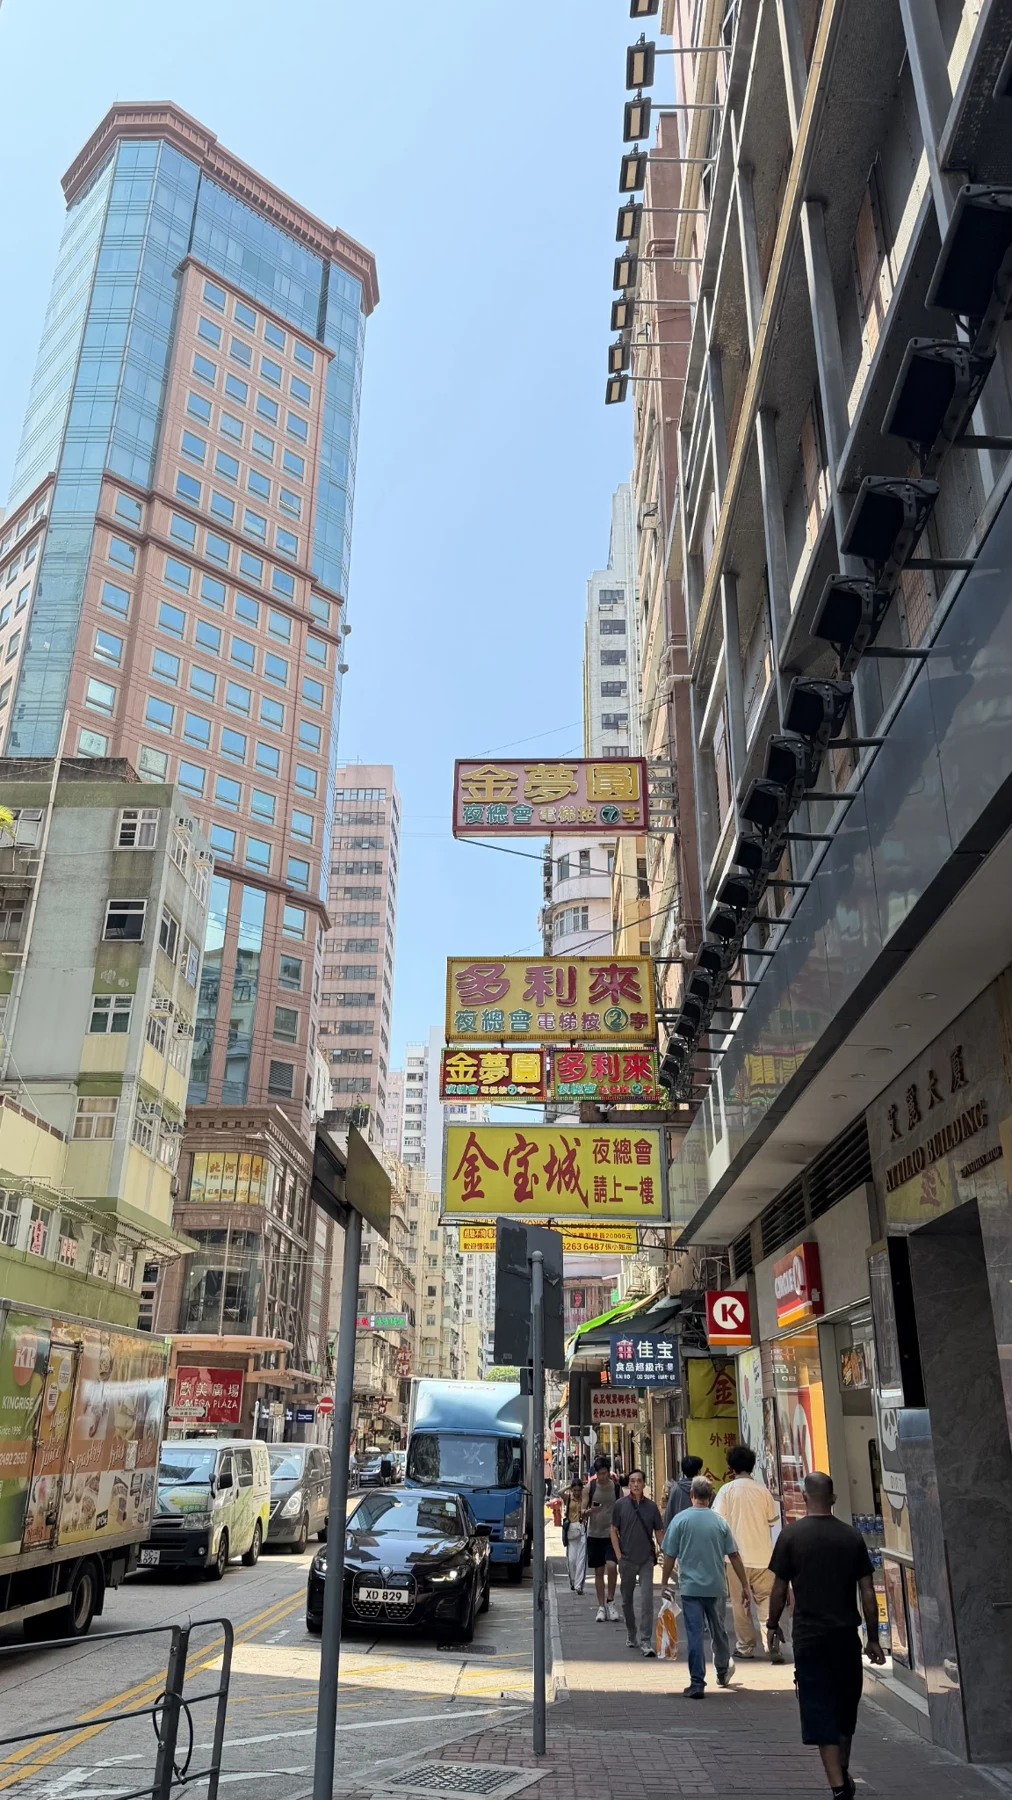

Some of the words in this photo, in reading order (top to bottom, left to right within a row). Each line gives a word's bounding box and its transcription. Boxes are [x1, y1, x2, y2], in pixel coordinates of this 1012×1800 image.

[462, 804, 534, 825] 夜總會
[455, 963, 642, 1006] 多利來
[455, 1009, 533, 1032] 夜總會
[557, 1052, 653, 1082] 多利來
[927, 1101, 988, 1164] BUILDING
[592, 1137, 653, 1165] 夜總會
[593, 1176, 654, 1204] 請上一樓
[616, 1362, 674, 1372] 食品超級市場
[180, 1381, 240, 1398] 歐美廣場
[706, 1363, 737, 1406] 金
[2, 1396, 35, 1410] KINGRISE
[179, 1399, 211, 1409] OMEGA
[213, 1400, 238, 1409] PLAZA
[365, 1590, 379, 1600] XD
[382, 1590, 402, 1601] 829
